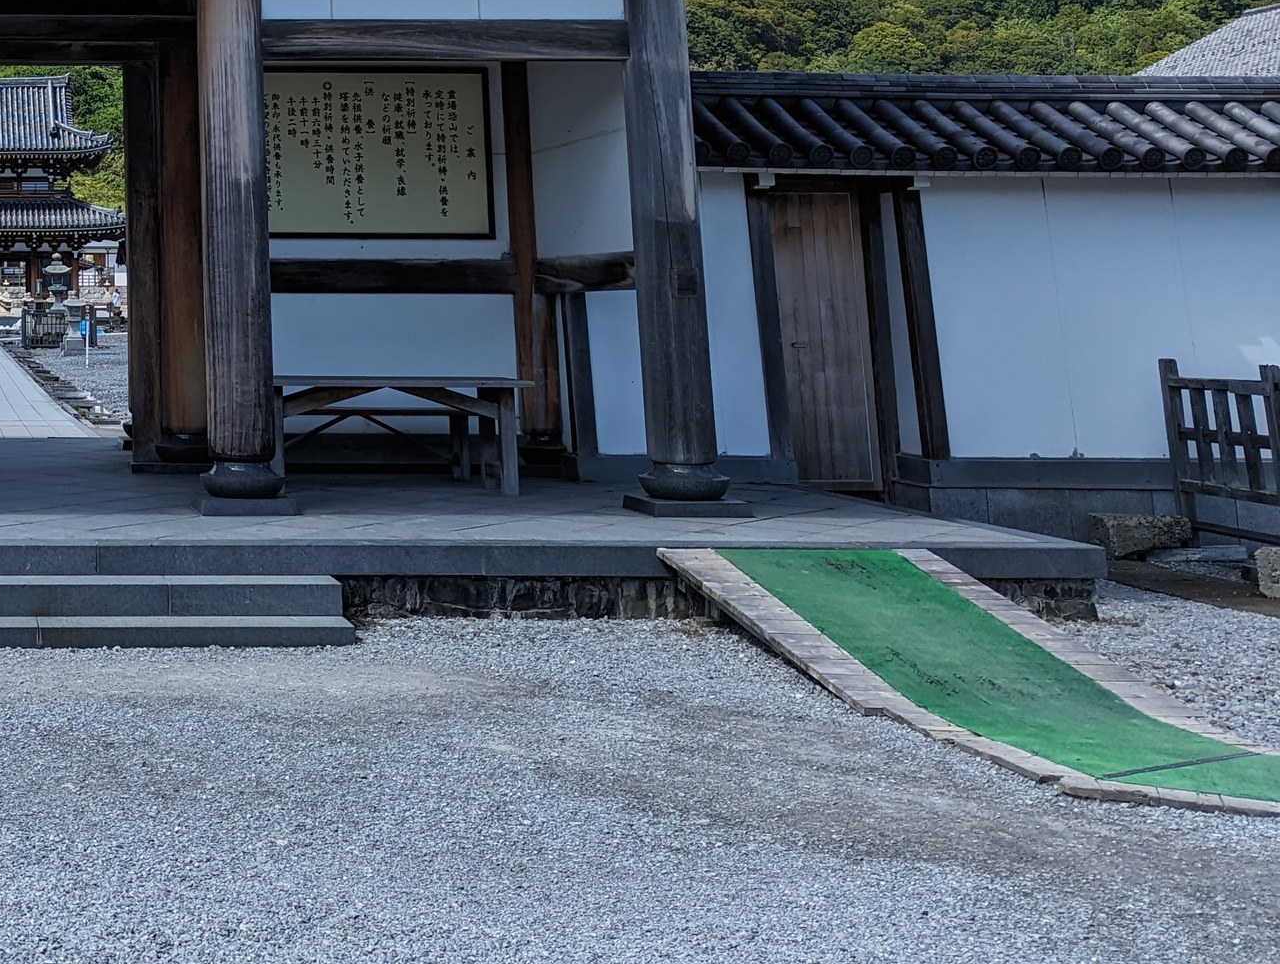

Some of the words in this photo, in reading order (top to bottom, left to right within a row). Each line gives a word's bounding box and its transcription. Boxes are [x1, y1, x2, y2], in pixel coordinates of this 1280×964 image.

[286, 96, 297, 138] 午後二時
[299, 96, 310, 148] 午前十一時
[311, 96, 323, 169] 午前六時三十分
